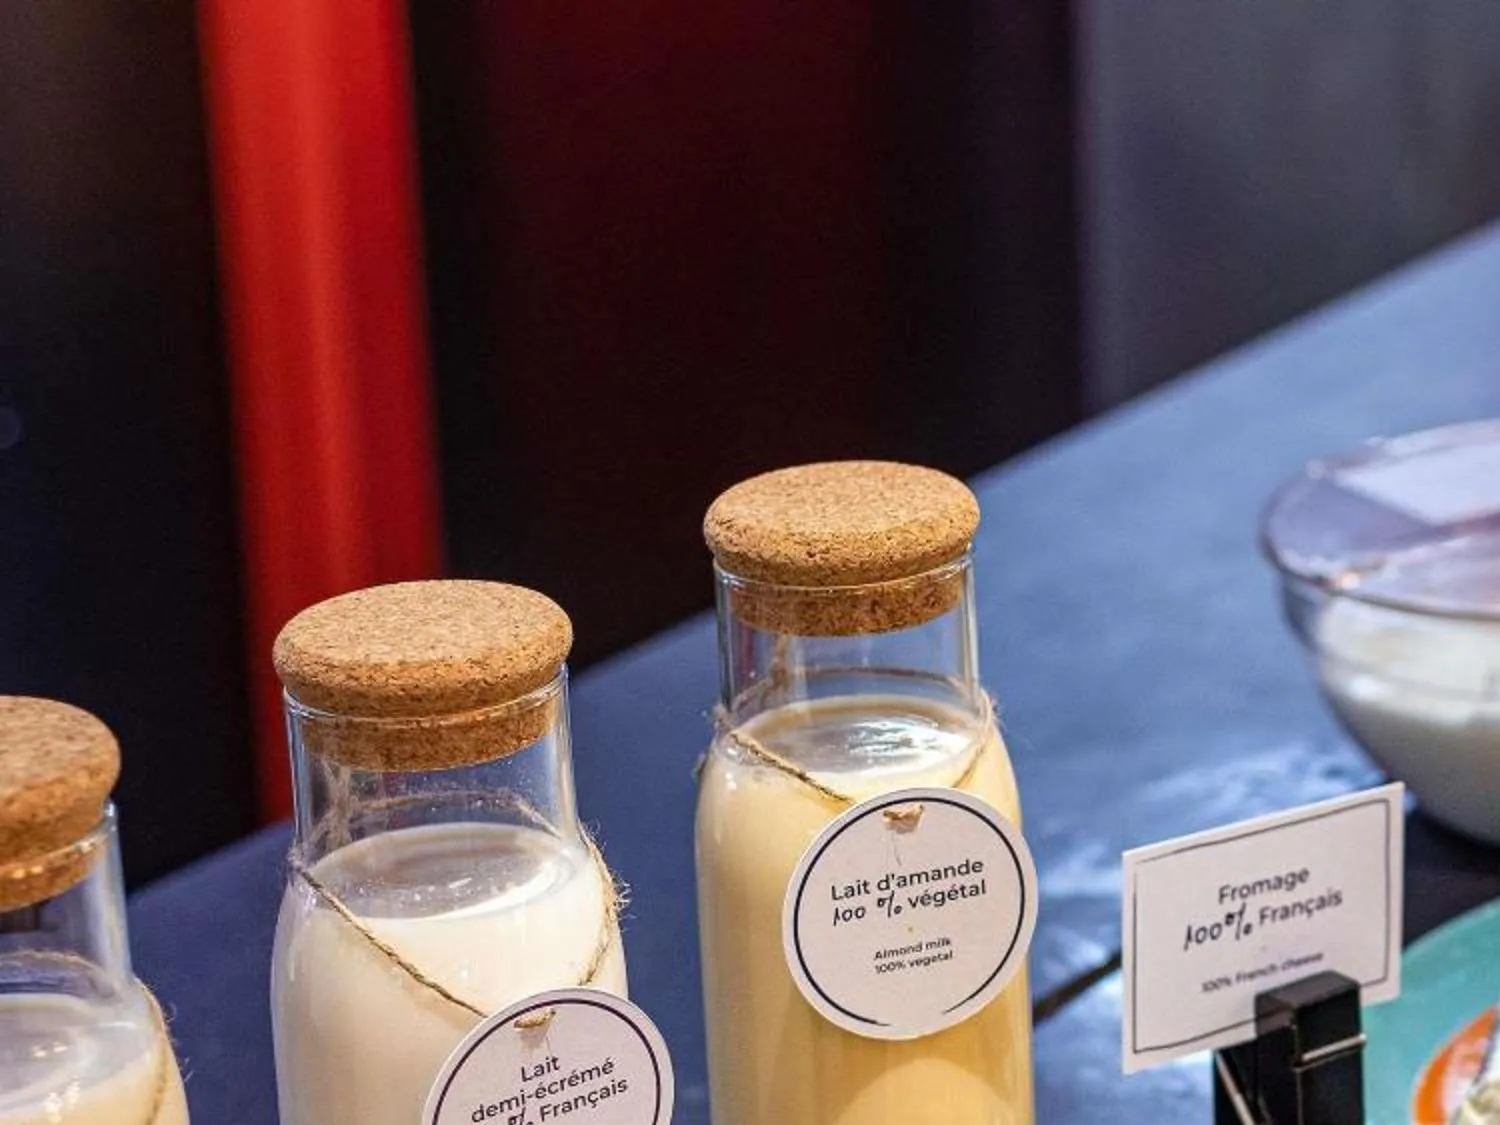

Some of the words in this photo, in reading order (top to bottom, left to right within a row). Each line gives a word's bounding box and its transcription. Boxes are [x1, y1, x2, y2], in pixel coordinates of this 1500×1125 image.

[831, 879, 870, 901] Lait
[876, 858, 984, 892] d'amande
[907, 879, 987, 910] végétal
[1218, 867, 1310, 904] Fromage
[1258, 887, 1343, 928] Français
[874, 941, 923, 961] Almond
[925, 937, 952, 952] milk
[875, 960, 906, 974] 100%
[908, 951, 953, 969] vegetal
[1201, 978, 1232, 994] 100%
[1235, 963, 1278, 984] French
[1281, 952, 1324, 972] cheese
[521, 1055, 561, 1083] Lait
[471, 1056, 616, 1124] demi-écrémé
[540, 1078, 629, 1122] Français
